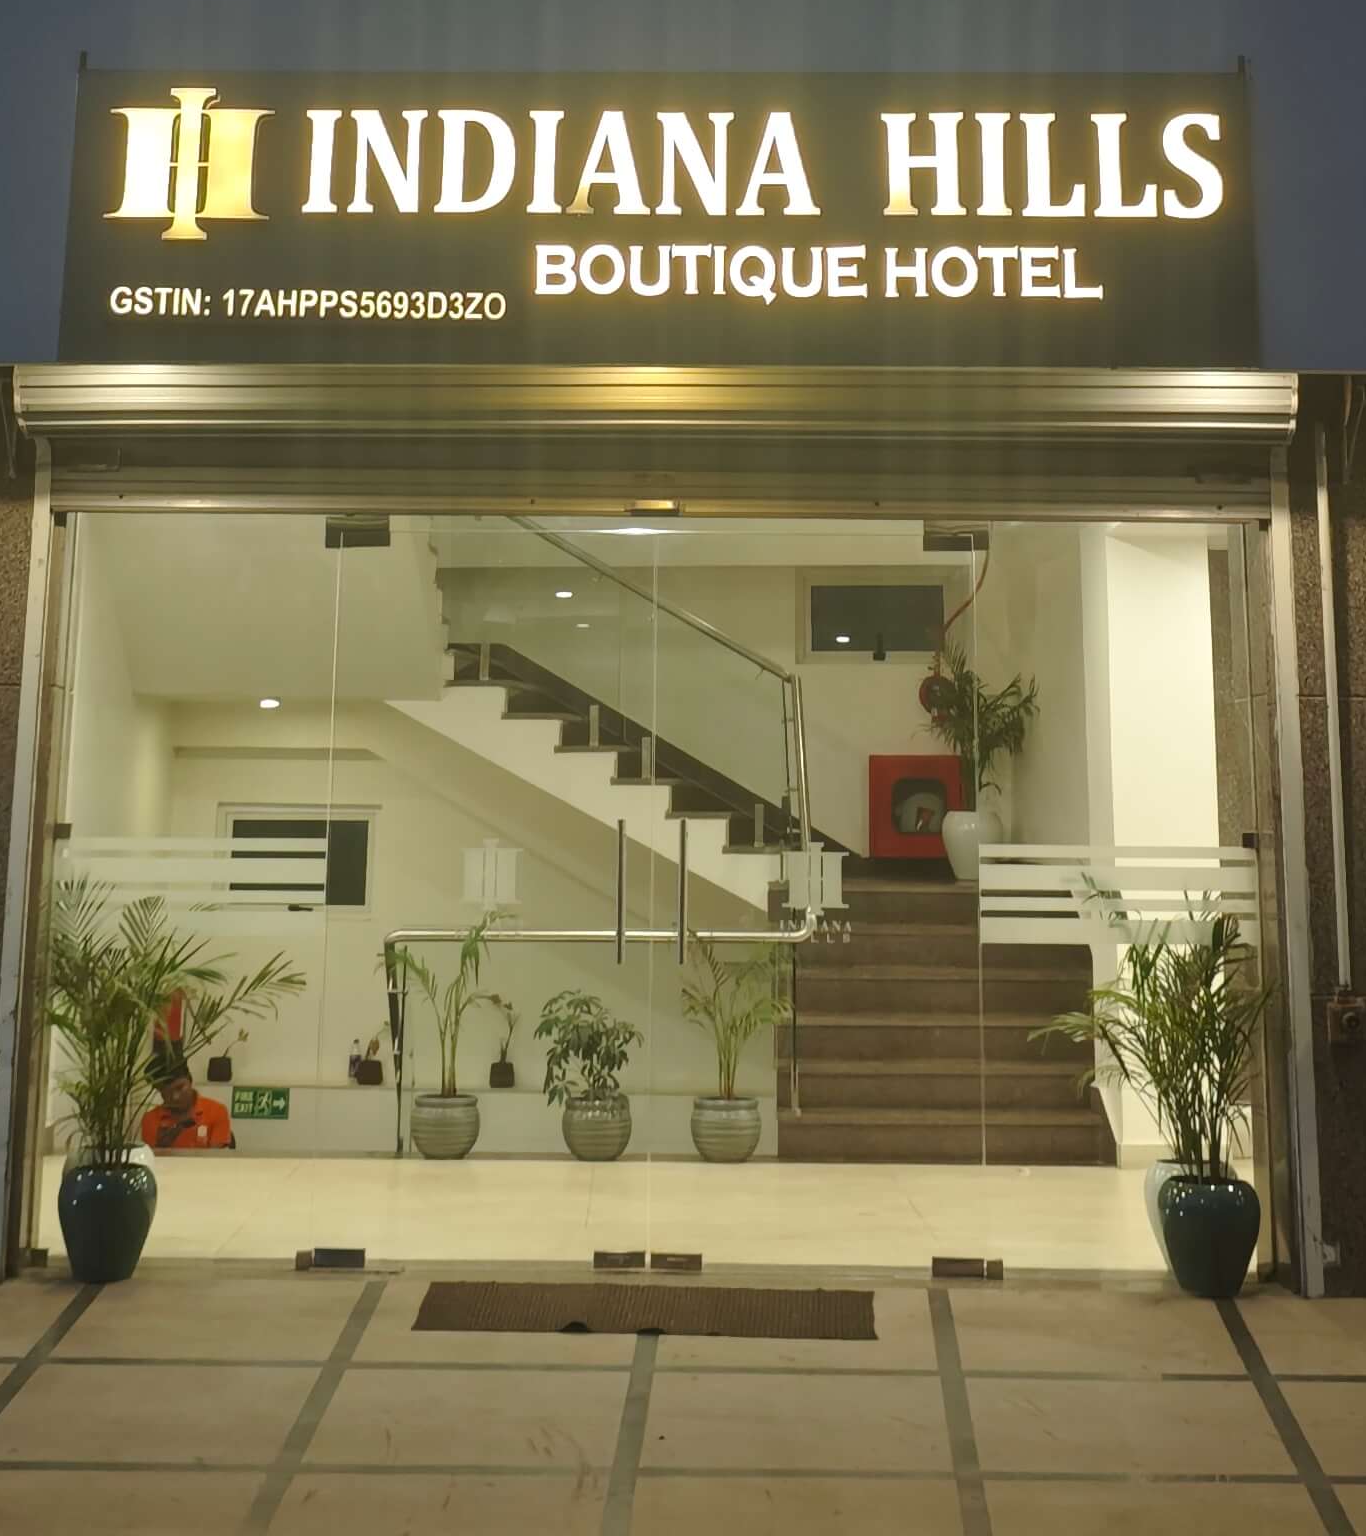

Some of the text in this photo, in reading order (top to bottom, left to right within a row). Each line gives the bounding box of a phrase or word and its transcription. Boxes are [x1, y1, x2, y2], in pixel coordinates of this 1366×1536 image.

[301, 109, 1224, 219] INDIANA HILLS
[110, 286, 211, 316] GSTIN:
[534, 243, 1104, 305] BOUTIQUE HOTEL
